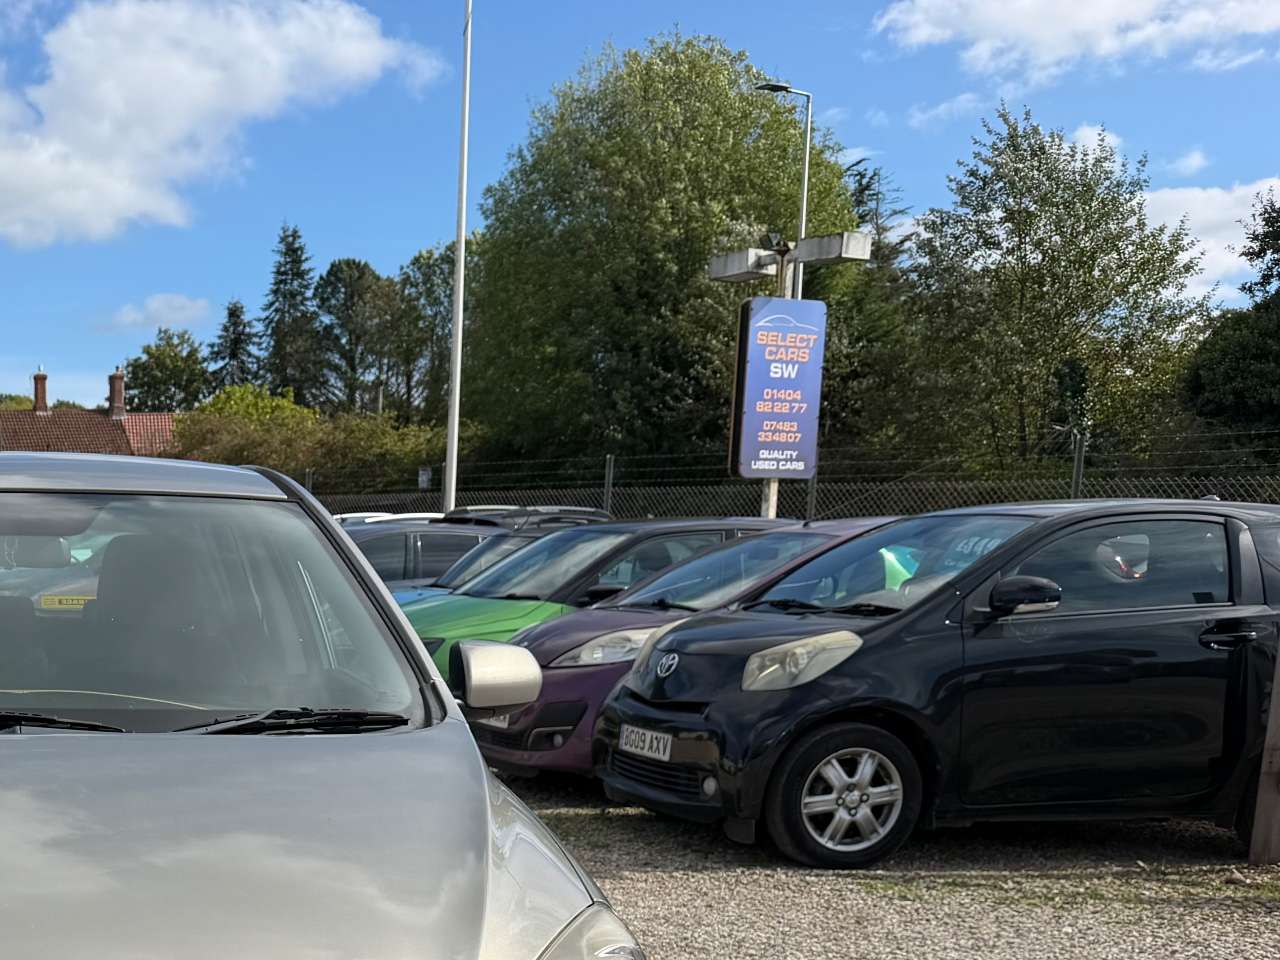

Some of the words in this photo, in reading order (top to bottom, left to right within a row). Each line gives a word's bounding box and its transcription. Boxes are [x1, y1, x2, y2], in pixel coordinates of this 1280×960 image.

[756, 331, 818, 348] SELECT
[765, 347, 810, 363] CARS
[770, 362, 799, 379] SW
[763, 388, 801, 401] 01404
[759, 449, 798, 460] QUALITY
[751, 461, 777, 470] USED
[778, 461, 805, 471] CARS
